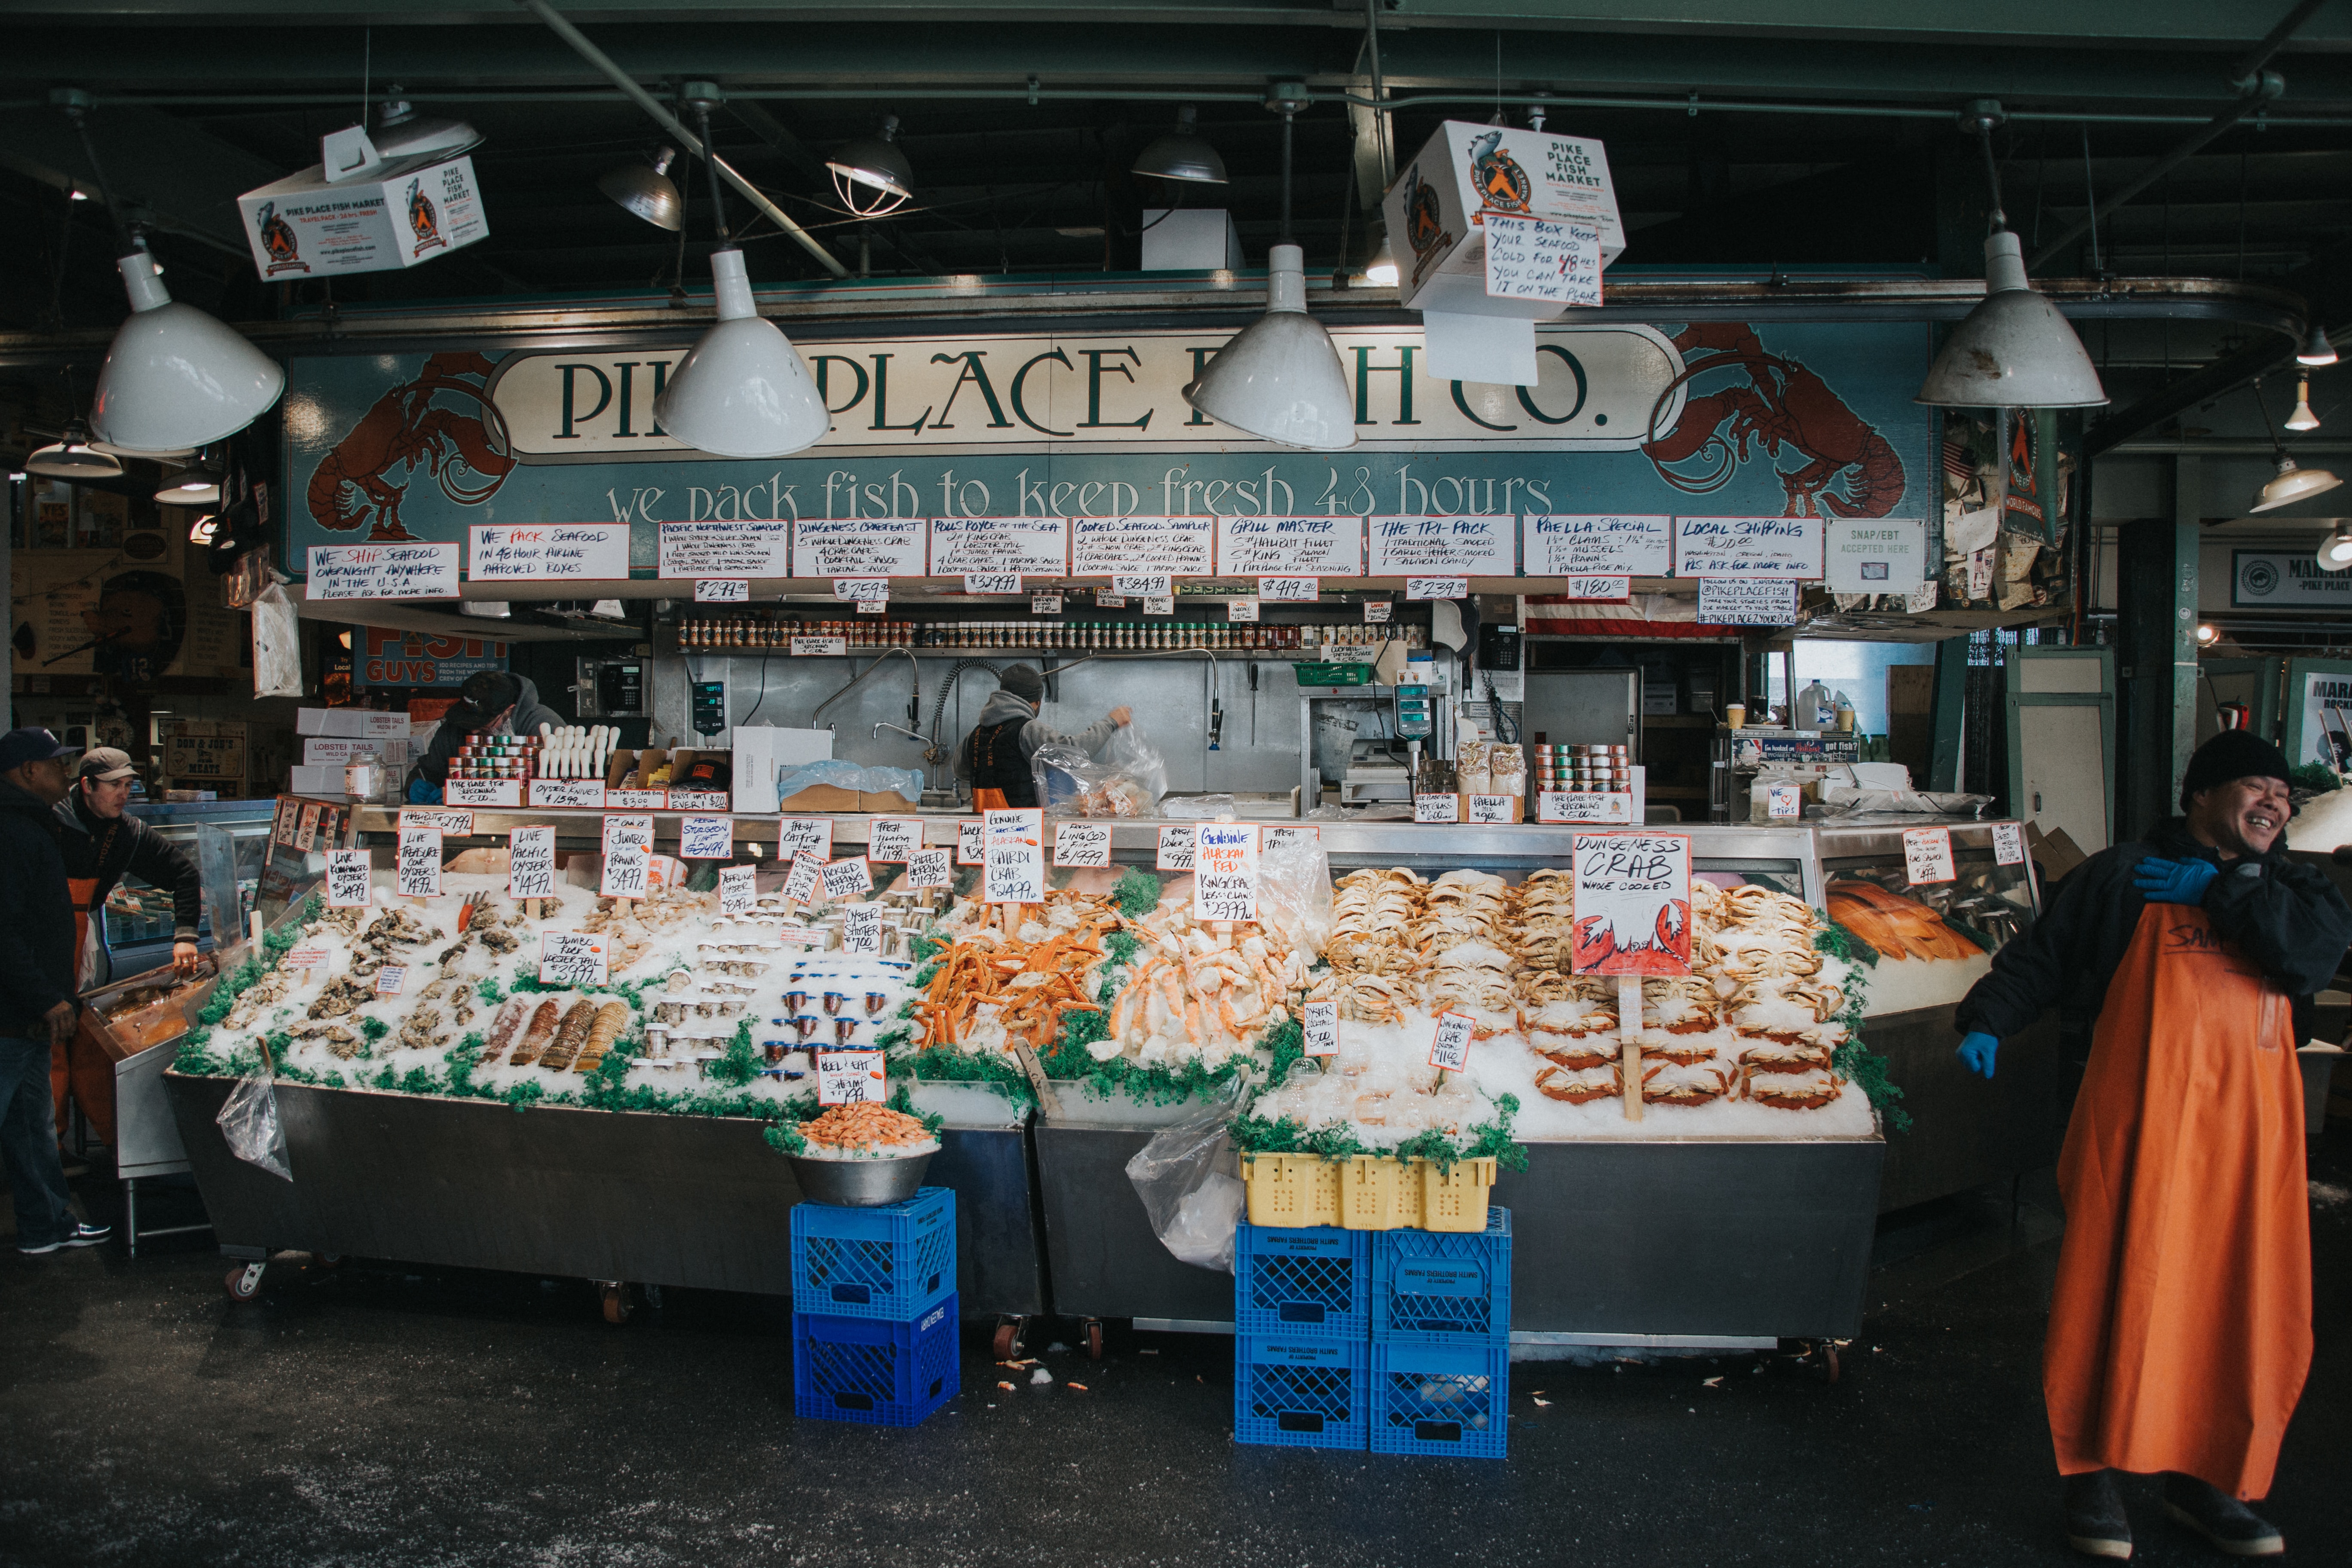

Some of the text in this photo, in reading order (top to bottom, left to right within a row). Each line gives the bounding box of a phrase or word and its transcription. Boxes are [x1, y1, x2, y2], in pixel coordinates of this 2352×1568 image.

[1551, 142, 1582, 155] PIKE
[1547, 152, 1591, 166] PLACE
[444, 168, 459, 178] PIKE
[1556, 163, 1587, 175] FISH
[442, 176, 464, 187] PLACE
[1546, 172, 1600, 187] MARKET
[447, 184, 462, 194] FISH
[444, 190, 470, 204] MARKET
[285, 198, 385, 216] PIKE PLACE FISH MARKET
[1489, 217, 1564, 236] THIS BOX
[1534, 237, 1580, 251] SEAFOOD
[1491, 248, 1553, 264] COLD FOR
[1494, 266, 1599, 285] YOU CAN TAKE
[1496, 282, 1509, 292] IT
[809, 345, 1154, 437] PLACE
[1450, 344, 1608, 431] CO.
[605, 463, 1553, 524] we pack fish to keep fresh 48 hours
[2006, 496, 2042, 519] WORLD FAMOUS
[696, 523, 747, 532] NORTHWEST
[748, 523, 787, 533] SAMPLER
[965, 521, 998, 531] ROYCE
[1231, 518, 1336, 535] GRILL MASTER
[1374, 521, 1413, 537] THE
[1536, 516, 1596, 534] PAELLA
[1682, 520, 1803, 537] LOCAL SHIPPING
[481, 528, 609, 544] WE PACK SEAFOOD
[1569, 535, 1610, 545] CLAMS
[1851, 530, 1899, 540] SNAP/EBT
[1391, 538, 1451, 547] TRADITIONAL
[1573, 545, 1623, 553] MUSSELS
[1841, 544, 1909, 553] ACCEPTED HERE
[315, 548, 440, 565] WE SEAFOOD
[514, 549, 541, 559] HOUR
[824, 556, 899, 565] COCKTAIL SAUCE
[546, 563, 582, 573] BOXES
[824, 565, 893, 574] TARTAR SAUCE
[1709, 560, 1730, 570] ASK
[1730, 560, 1750, 570] FOR
[343, 578, 369, 588] THE
[968, 574, 1016, 591] $329.99
[1117, 576, 1165, 591] $384.99
[2325, 581, 2350, 591] PLACE
[323, 588, 358, 599] PLEASE
[380, 588, 396, 597] FOR
[1702, 585, 1789, 596] @PIKEPLACEFISH
[366, 660, 436, 683] GUYS
[177, 738, 233, 749] DON JOE'S
[1825, 741, 1858, 752] got fish?
[188, 764, 220, 774] MEATS
[536, 785, 600, 796] OYSTER KNIVES
[1769, 787, 1783, 797] WE
[1554, 802, 1600, 811] SEASONING
[683, 822, 729, 834] STURGEON
[612, 830, 647, 845] JUMBO
[1160, 836, 1185, 848] DOVER
[1574, 836, 1681, 852] DUNGENESS
[400, 846, 441, 858] TREASURE
[1057, 848, 1103, 866] $19.99
[1202, 846, 1248, 860] ALASKAN
[610, 852, 643, 867] PRAWNS
[798, 853, 824, 867] MEDIUM
[908, 852, 944, 867] SALTED
[401, 867, 436, 877] OYSTERS
[512, 859, 553, 875] OYSTERS
[822, 863, 859, 879] PICKLED
[1213, 860, 1238, 873] RED
[1583, 852, 1672, 881] CRAB
[337, 873, 368, 883] OYSTERS
[991, 867, 1021, 881] CRAB
[722, 882, 752, 894] OYSTER
[788, 877, 811, 893] JAR
[1582, 880, 1672, 891] WHOLE COOKED
[846, 908, 881, 922] OYSTER
[844, 924, 879, 937] SHOOTER
[551, 935, 594, 946] JUMBO
[560, 945, 586, 956] ROCK
[543, 952, 578, 964] LOBSTER
[1305, 1004, 1334, 1019] OYSTER
[1306, 1018, 1335, 1029] COCKTAIL
[1439, 1029, 1462, 1043] CRAB
[821, 1056, 873, 1072] PEEL EAT
[921, 1319, 931, 1332] DAIRY
